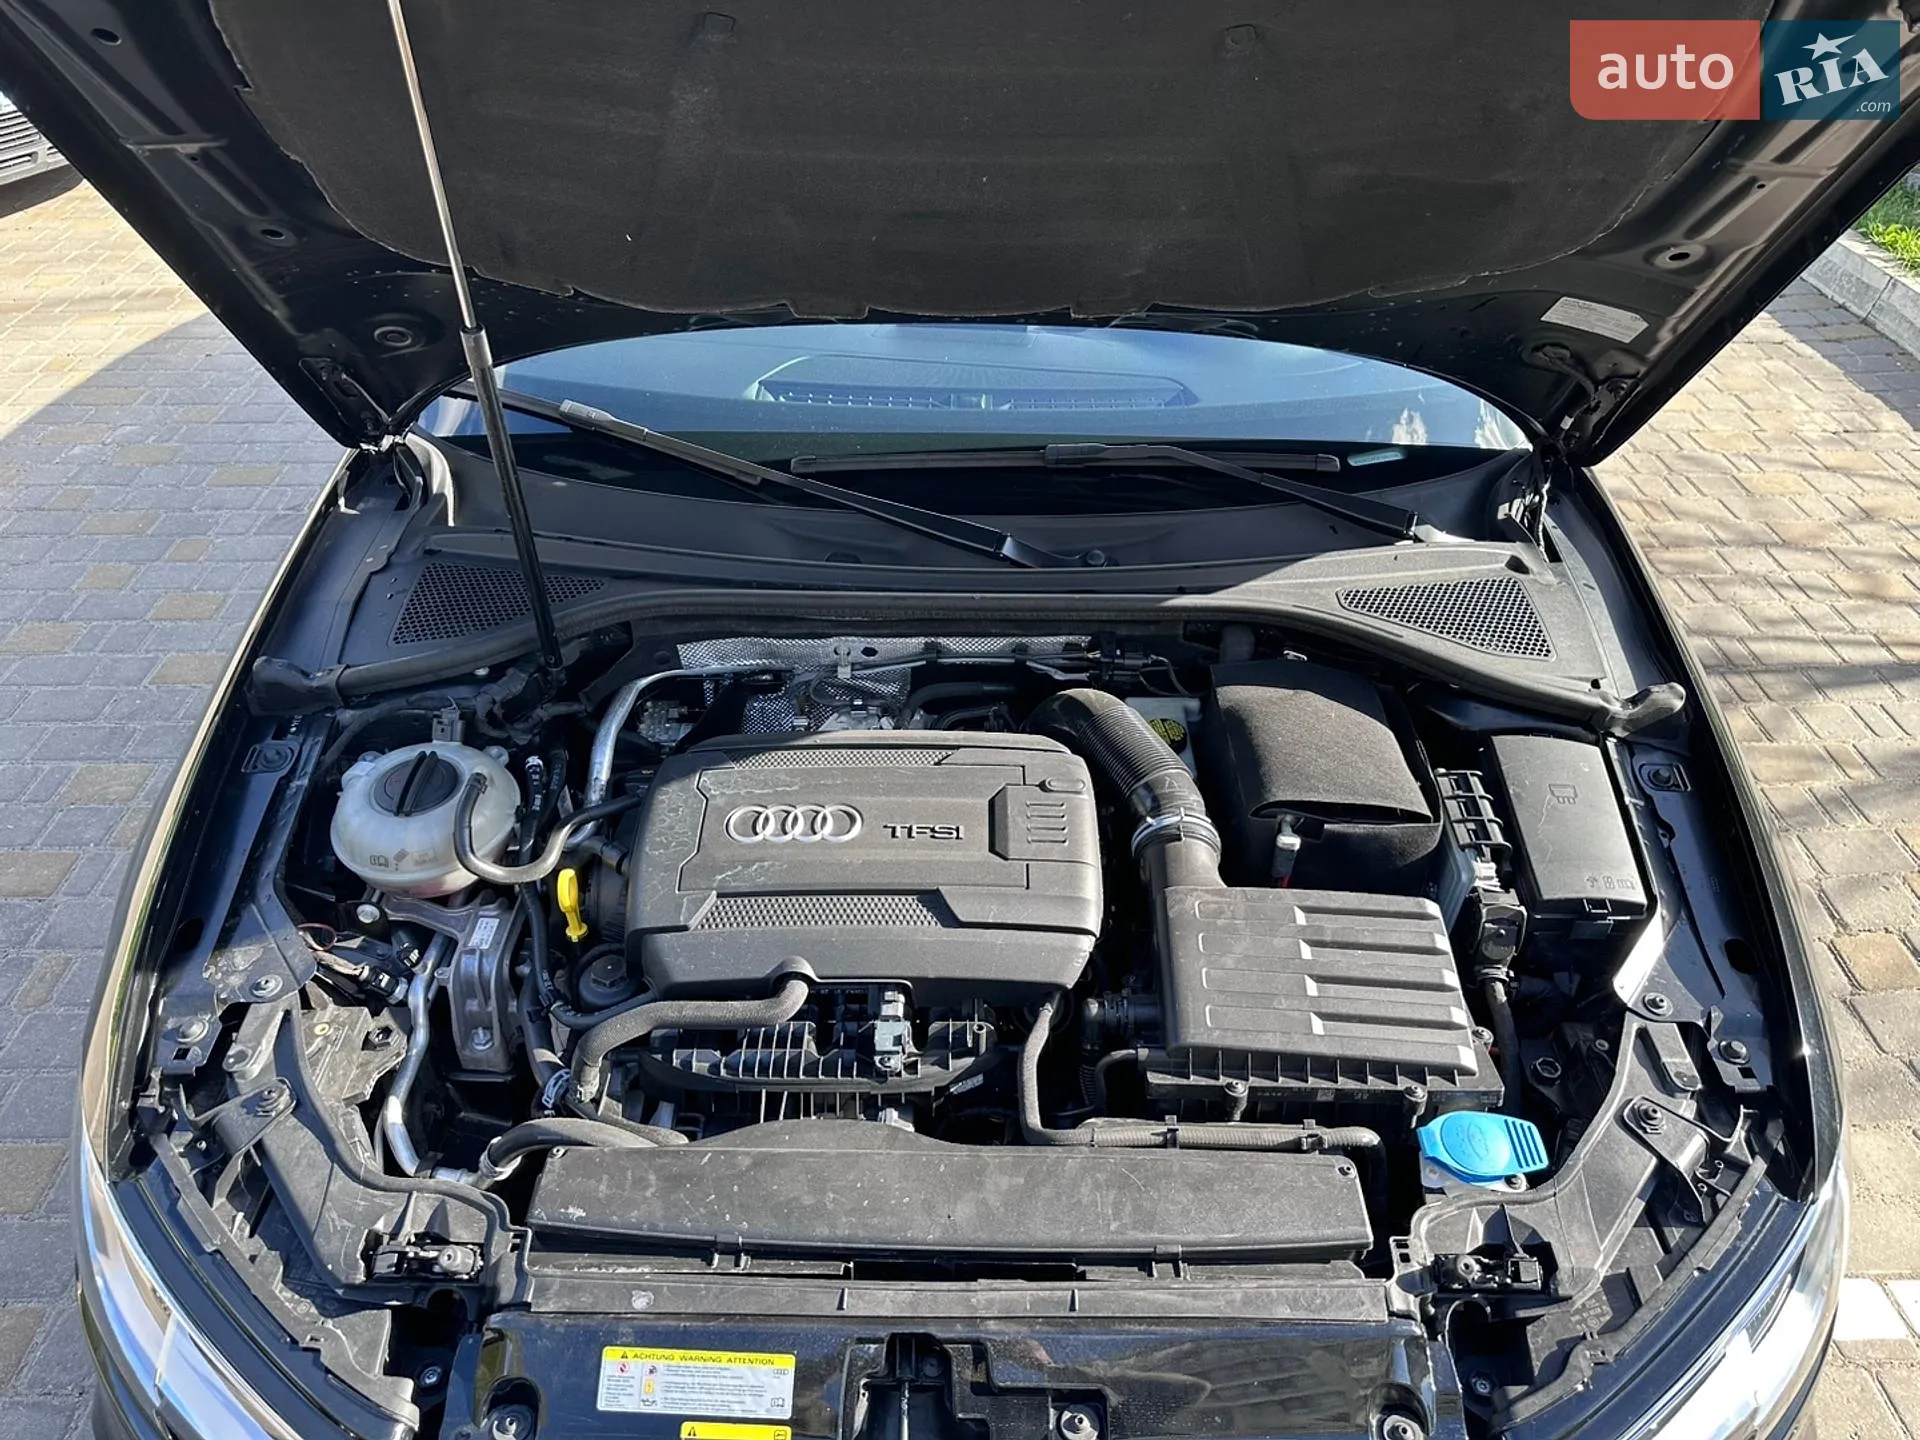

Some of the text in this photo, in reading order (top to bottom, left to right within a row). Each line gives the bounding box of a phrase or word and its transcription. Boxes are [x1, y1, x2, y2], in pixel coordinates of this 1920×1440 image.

[883, 823, 964, 841] TFSI
[632, 1352, 775, 1366] ACHTUNG WARNING ATTENTION
